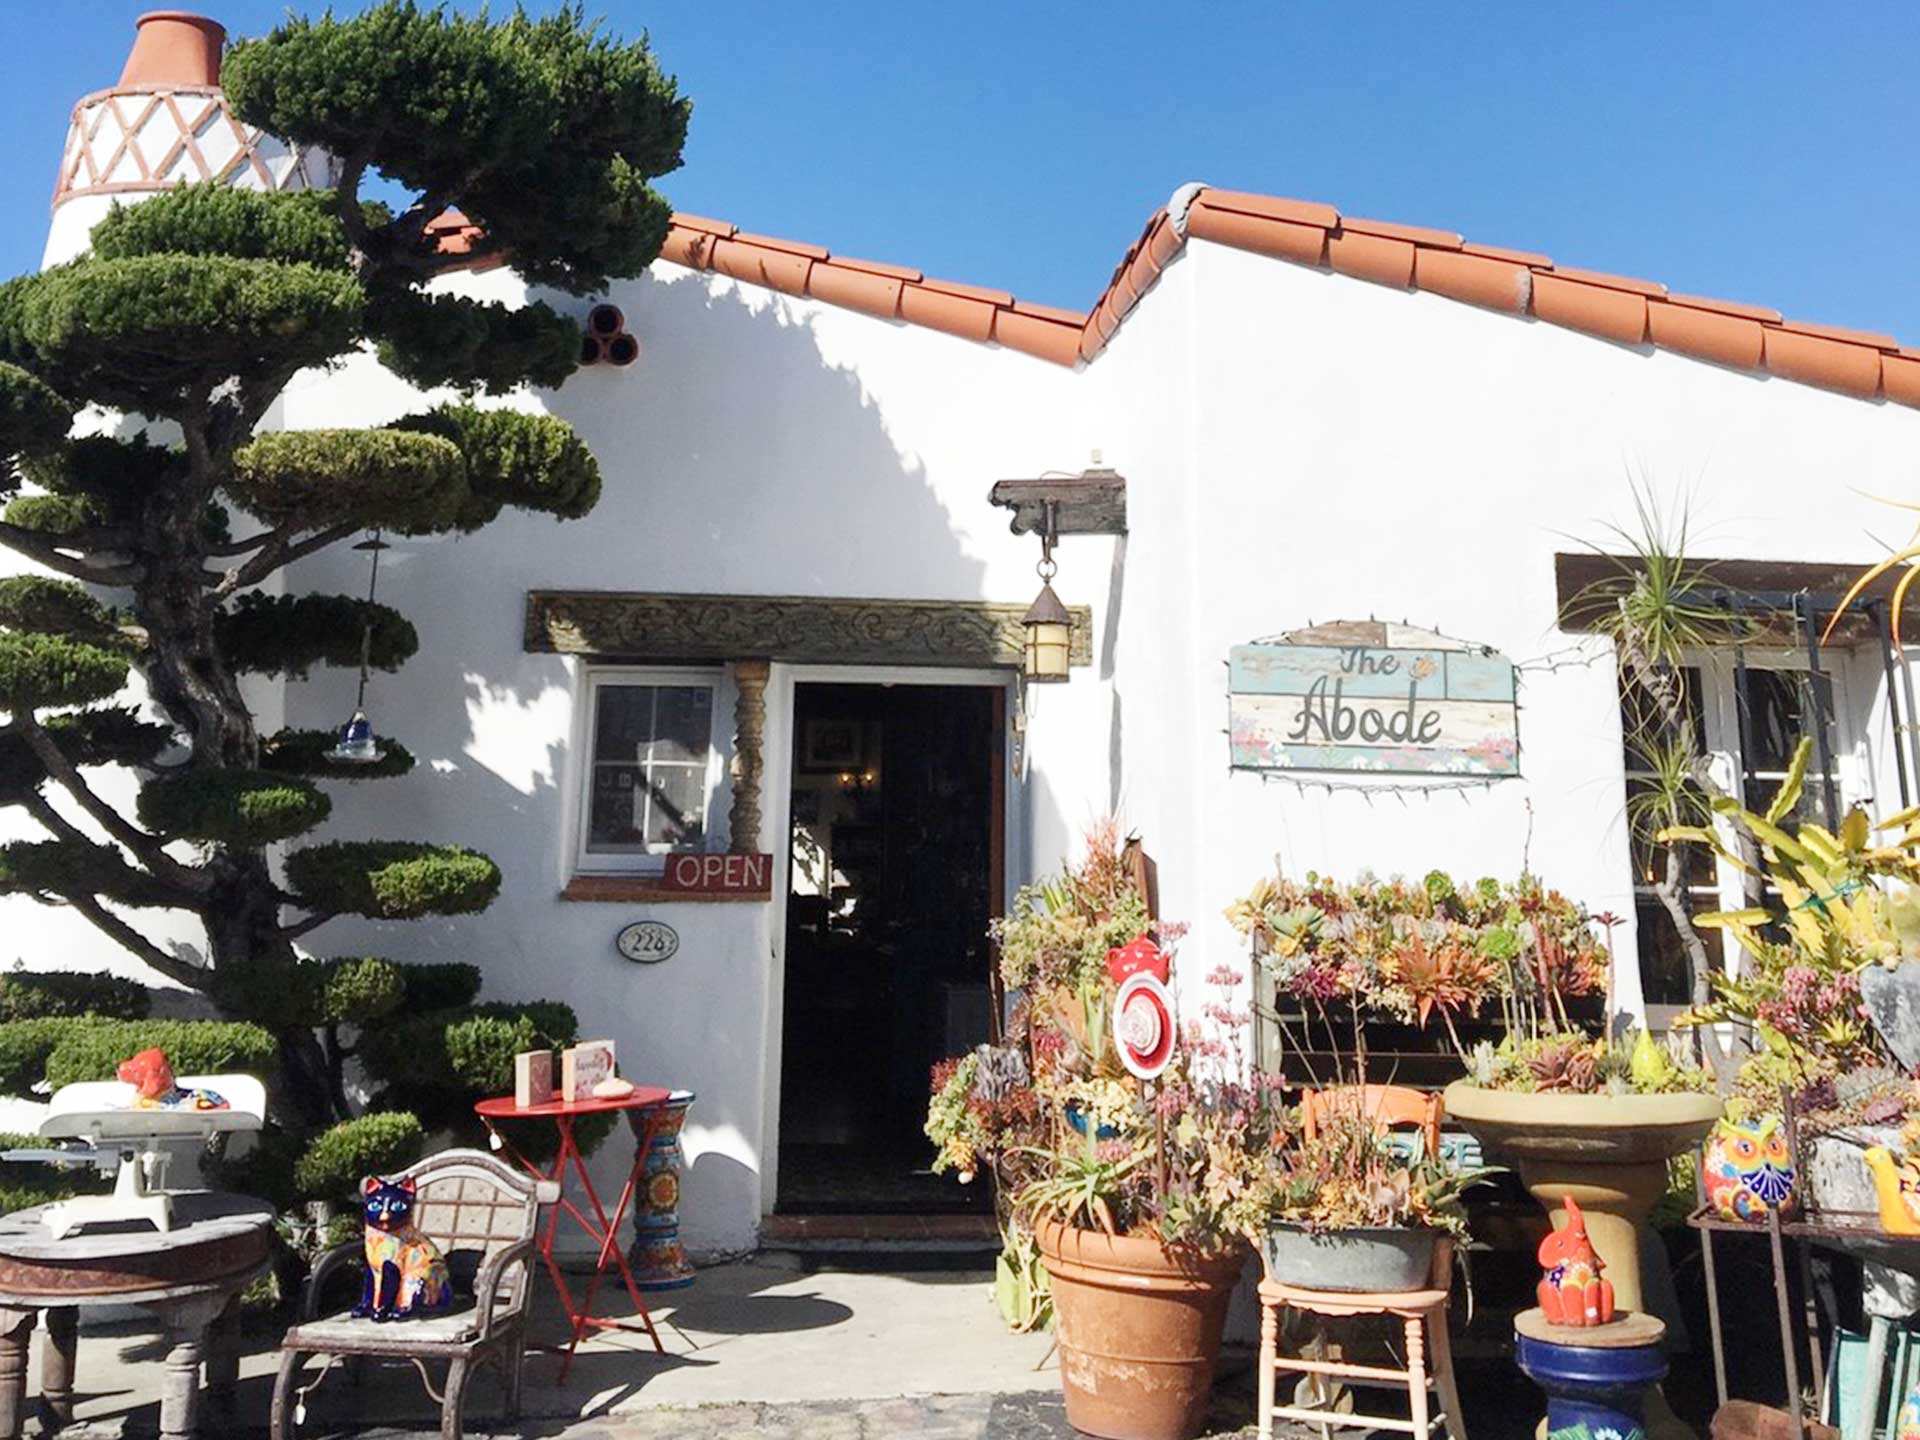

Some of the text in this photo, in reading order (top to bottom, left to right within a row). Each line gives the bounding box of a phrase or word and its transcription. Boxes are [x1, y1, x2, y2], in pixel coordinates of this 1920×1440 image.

[1340, 648, 1400, 674] The
[1288, 675, 1441, 743] Abode
[676, 856, 764, 887] OPEN
